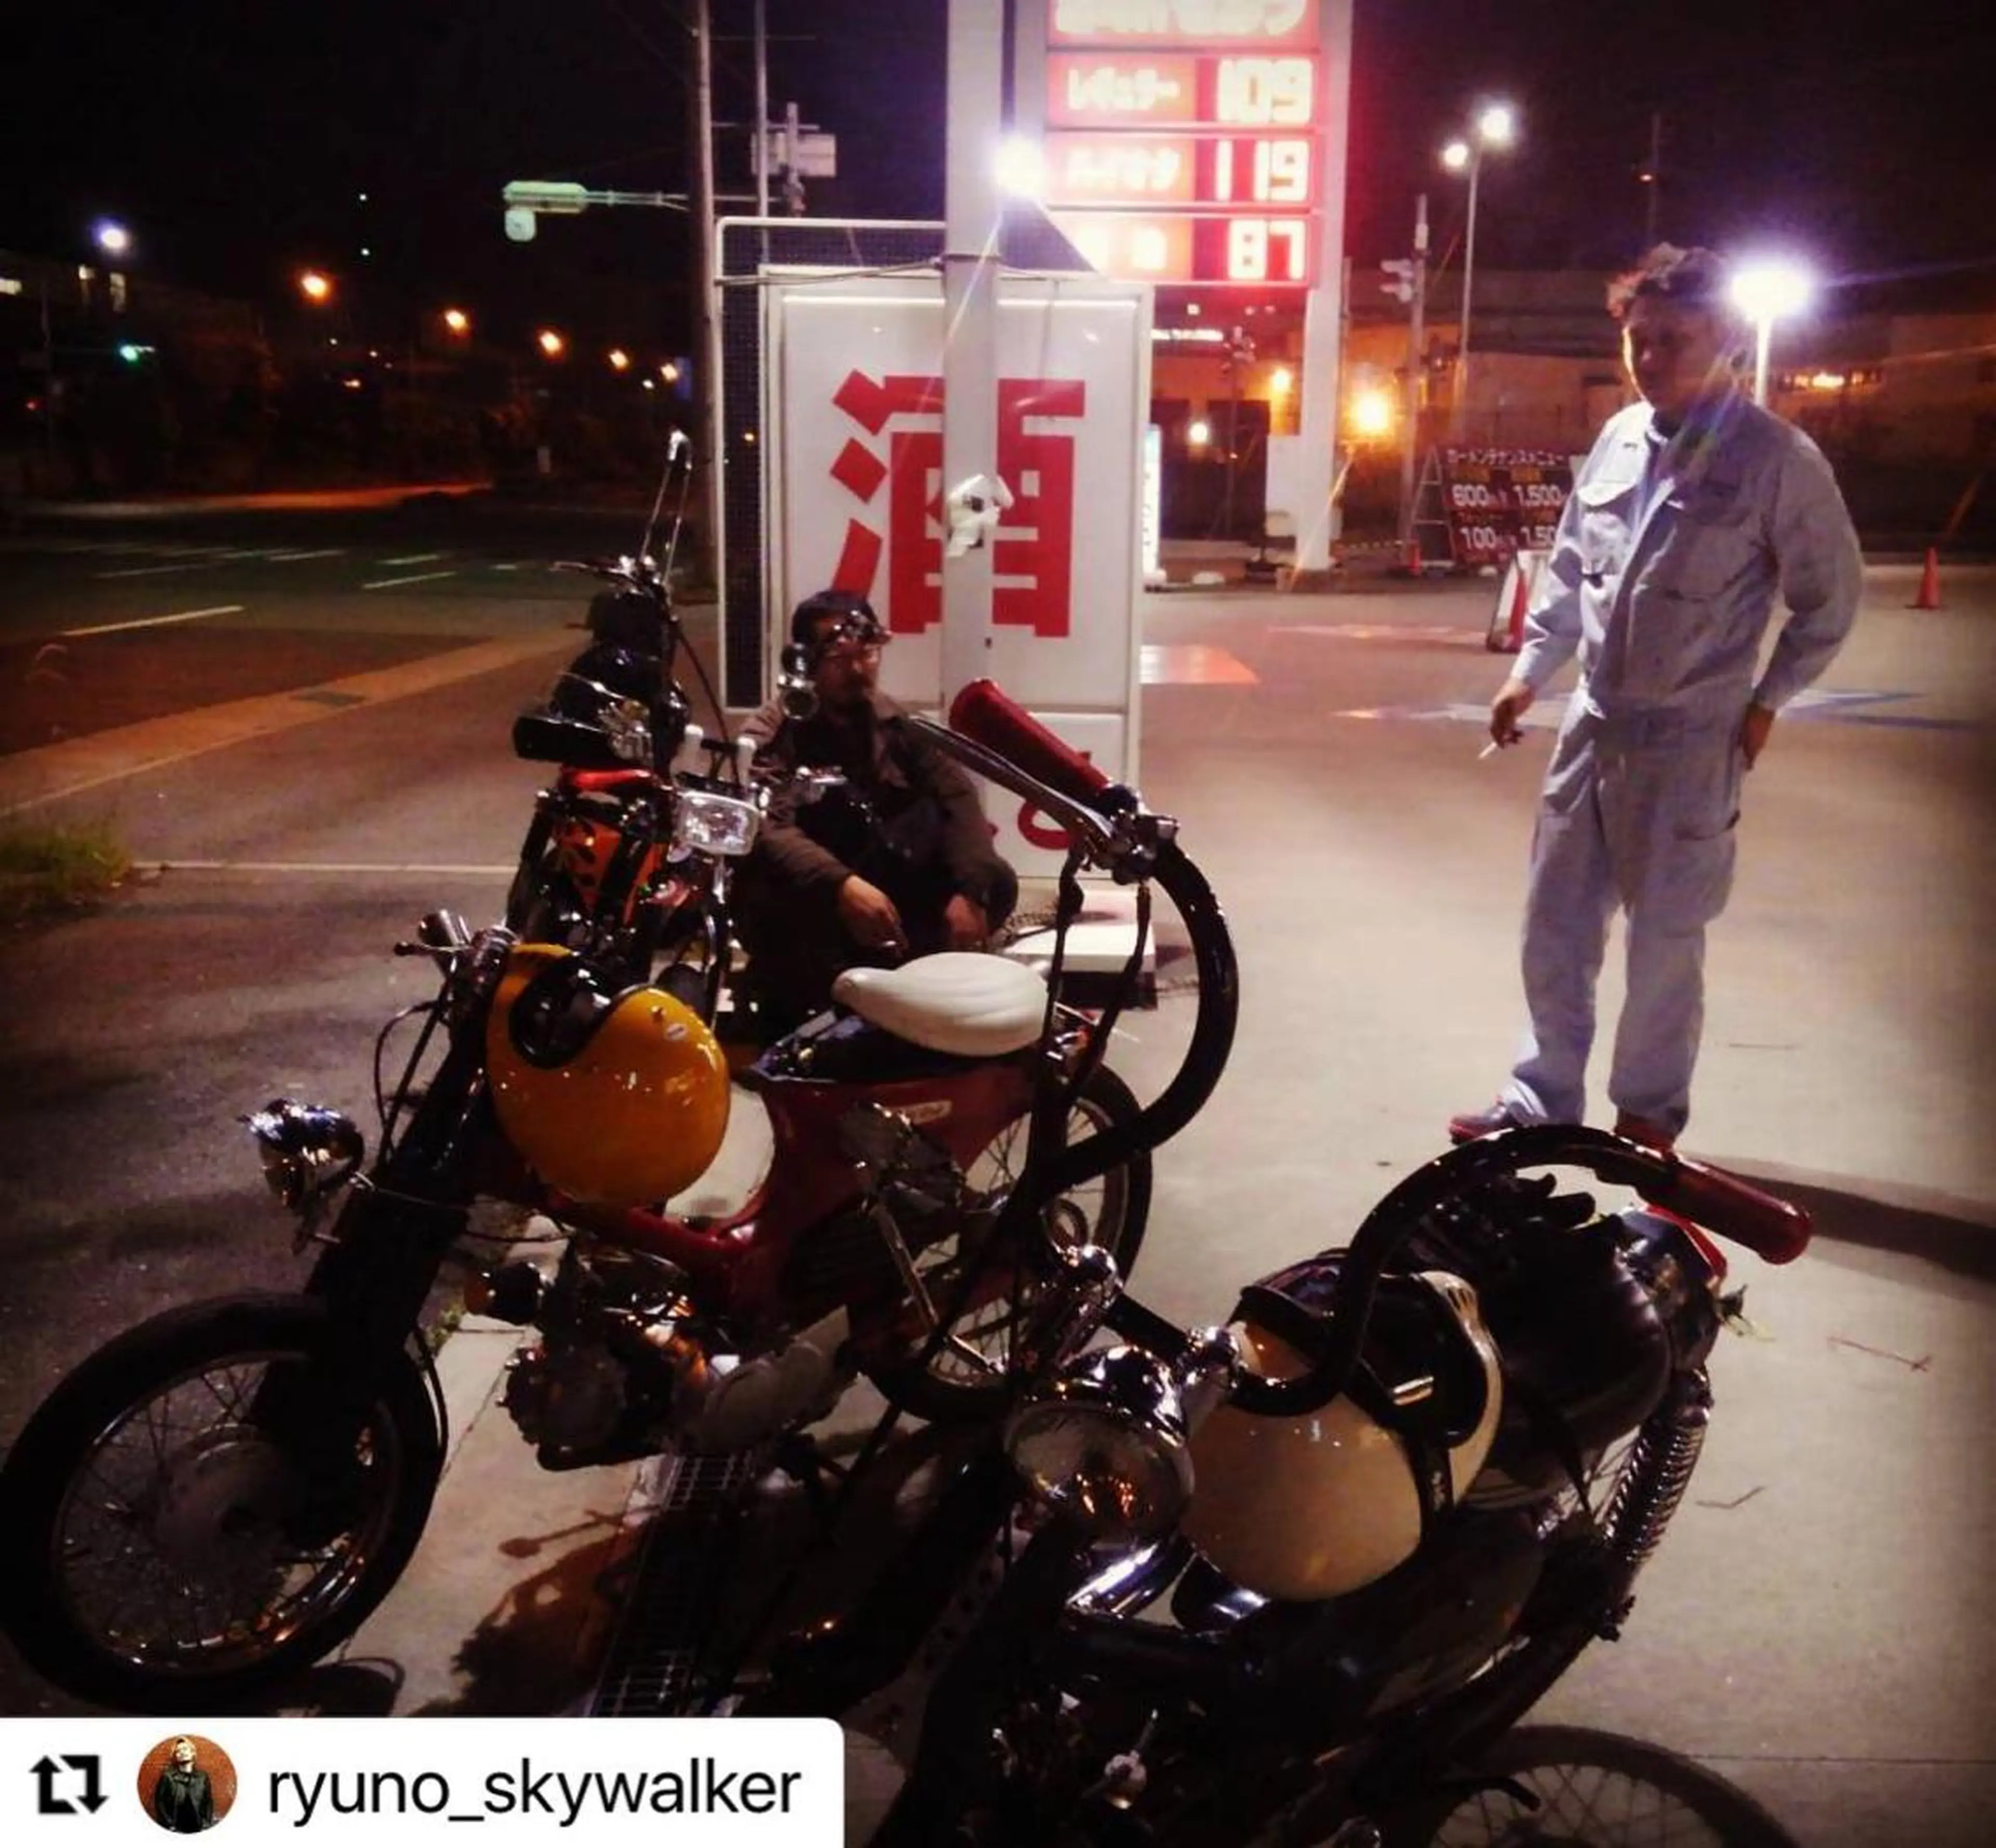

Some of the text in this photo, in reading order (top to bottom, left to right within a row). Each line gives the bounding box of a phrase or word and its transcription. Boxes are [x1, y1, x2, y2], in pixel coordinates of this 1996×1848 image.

[1217, 59, 1312, 123] 109
[1216, 140, 1309, 201] 119
[1229, 219, 1305, 279] 87
[829, 368, 1086, 638] 酒
